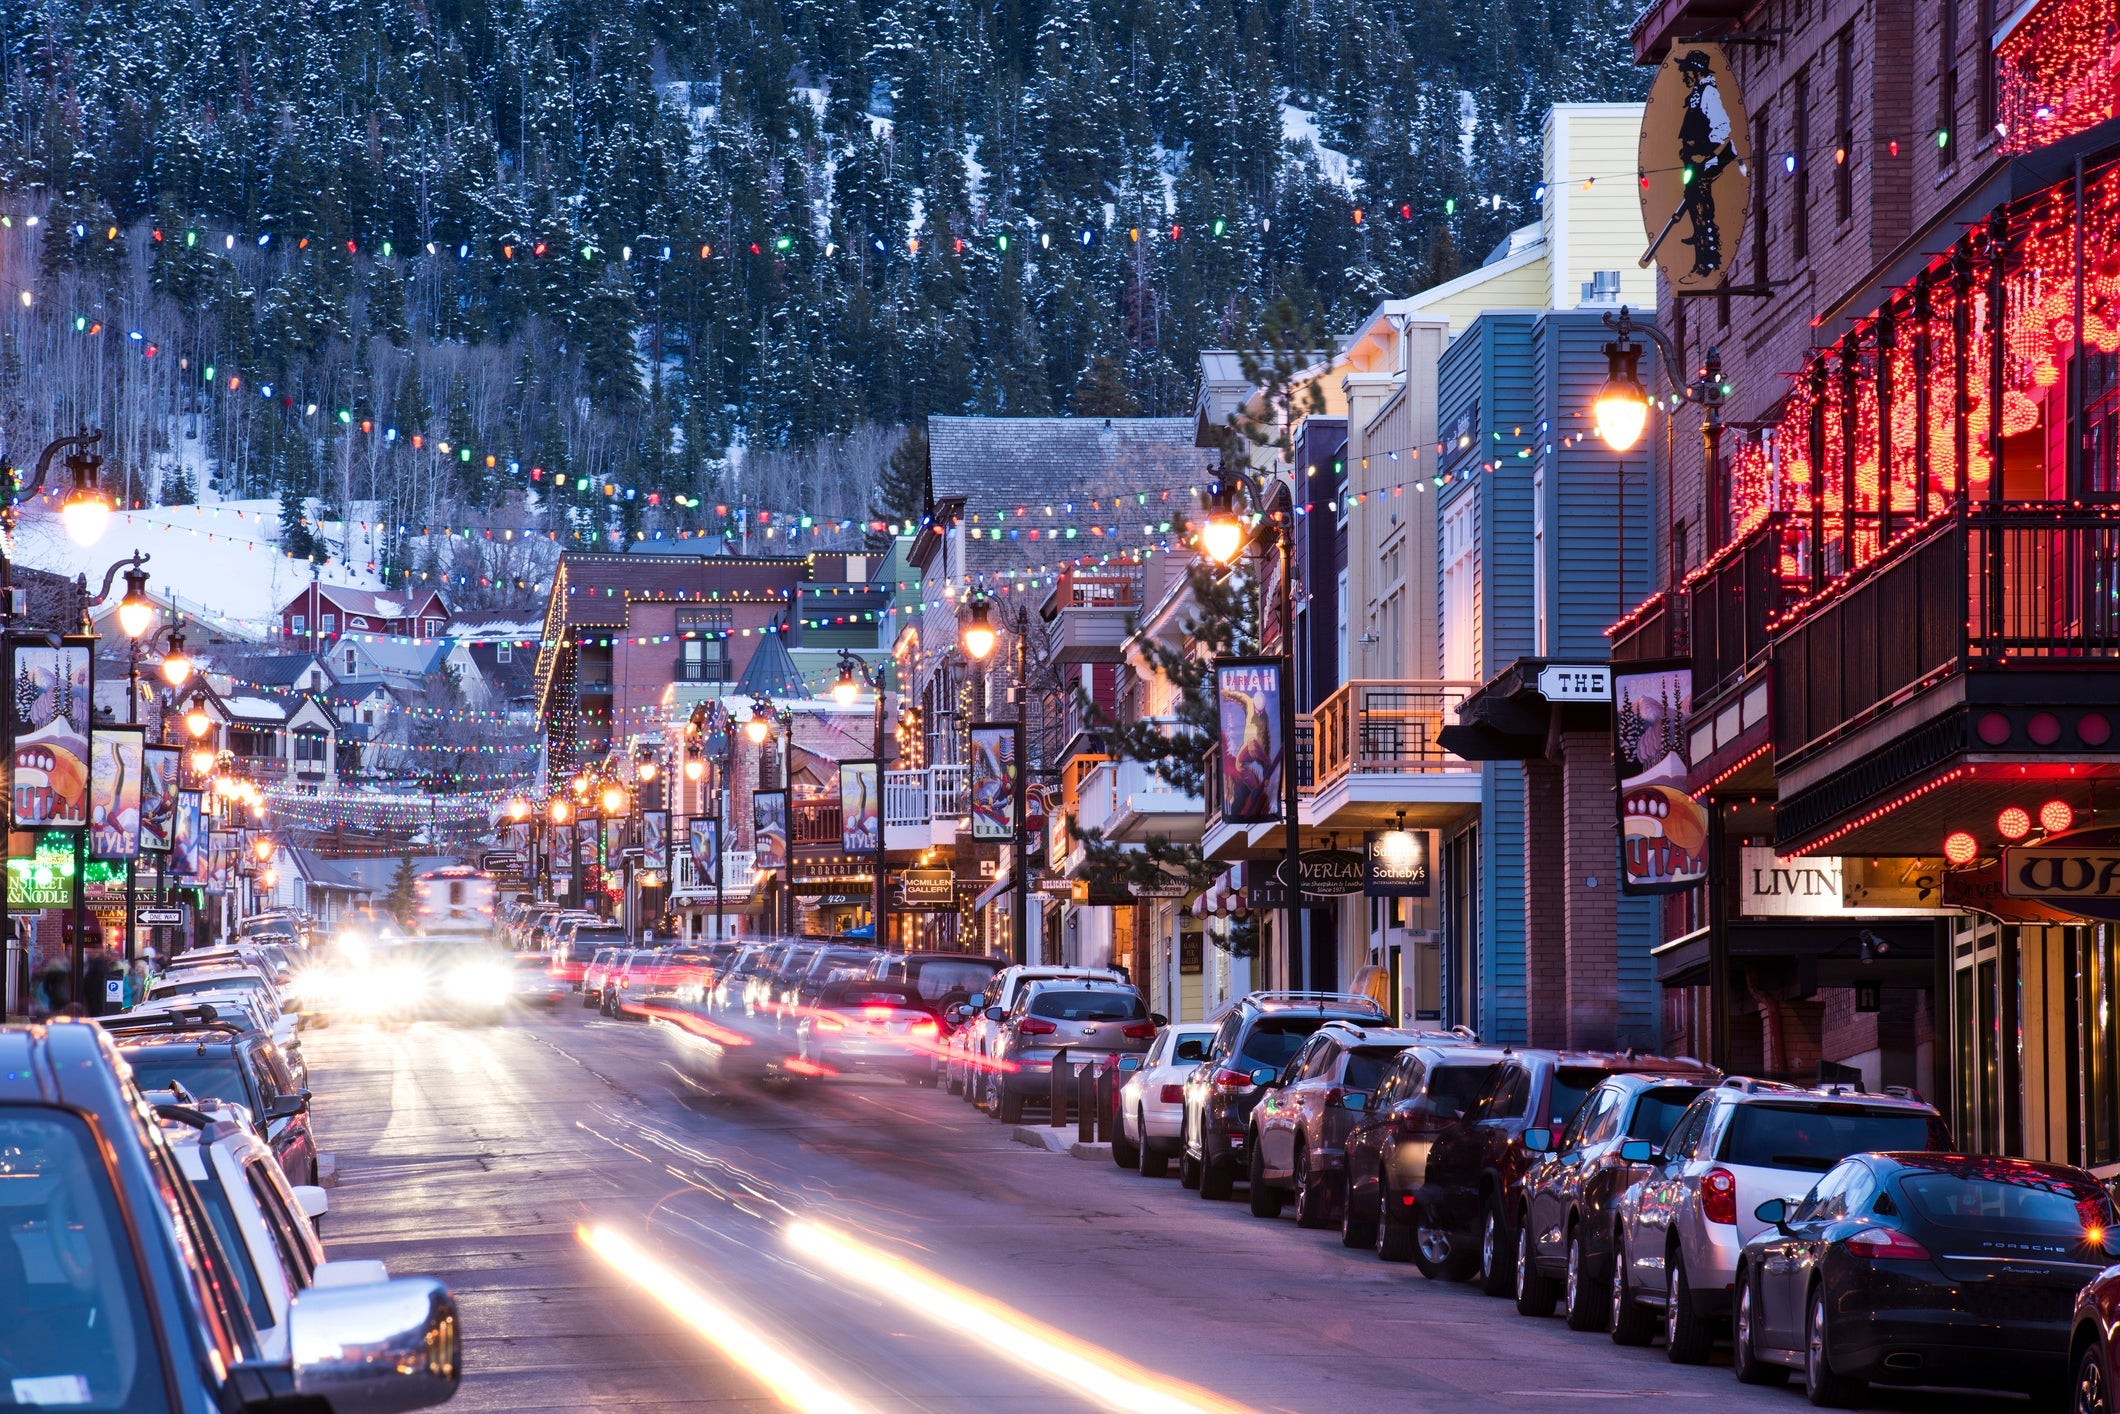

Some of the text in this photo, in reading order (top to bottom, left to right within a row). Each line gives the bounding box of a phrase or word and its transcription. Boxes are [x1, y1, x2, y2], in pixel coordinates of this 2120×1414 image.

[1222, 669, 1276, 691] UTAH
[1226, 675, 1272, 686] PARK CITY
[1558, 674, 1604, 693] THE
[16, 787, 86, 821] UTAH
[178, 794, 198, 807] TAH
[692, 821, 715, 832] UTAH
[91, 831, 134, 854] TYLE
[845, 833, 876, 849] STYLE
[1627, 836, 1708, 877] UTAH
[811, 865, 850, 875] ROBERT
[1373, 866, 1425, 881] Sotheby's
[827, 895, 846, 903] 425
[1983, 1241, 2065, 1253] PORSCHE
